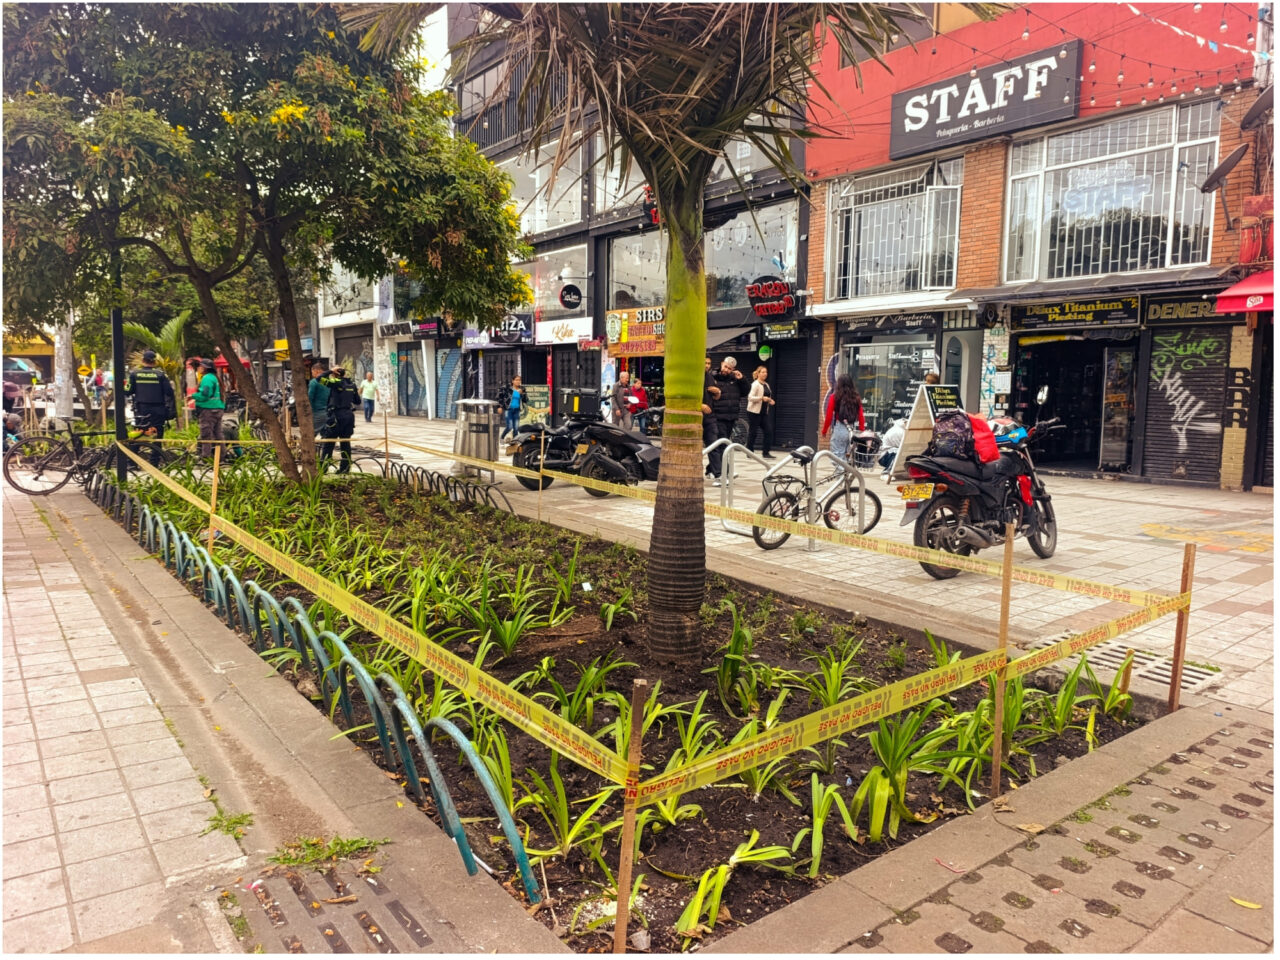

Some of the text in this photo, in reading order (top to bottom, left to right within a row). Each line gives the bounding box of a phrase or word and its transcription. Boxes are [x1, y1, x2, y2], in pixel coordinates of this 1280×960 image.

[904, 56, 1058, 133] STAFF
[1063, 300, 1123, 313] Titanium
[635, 307, 664, 323] SIRS
[931, 673, 957, 689] PELIGRO
[903, 688, 919, 699] PASE
[852, 701, 882, 718] PELIGRO
[543, 722, 560, 739] PASE
[818, 719, 838, 732] PASE
[757, 734, 795, 755] PELIGRO
[573, 741, 603, 768] PELIGRO
[715, 756, 741, 771] PASE
